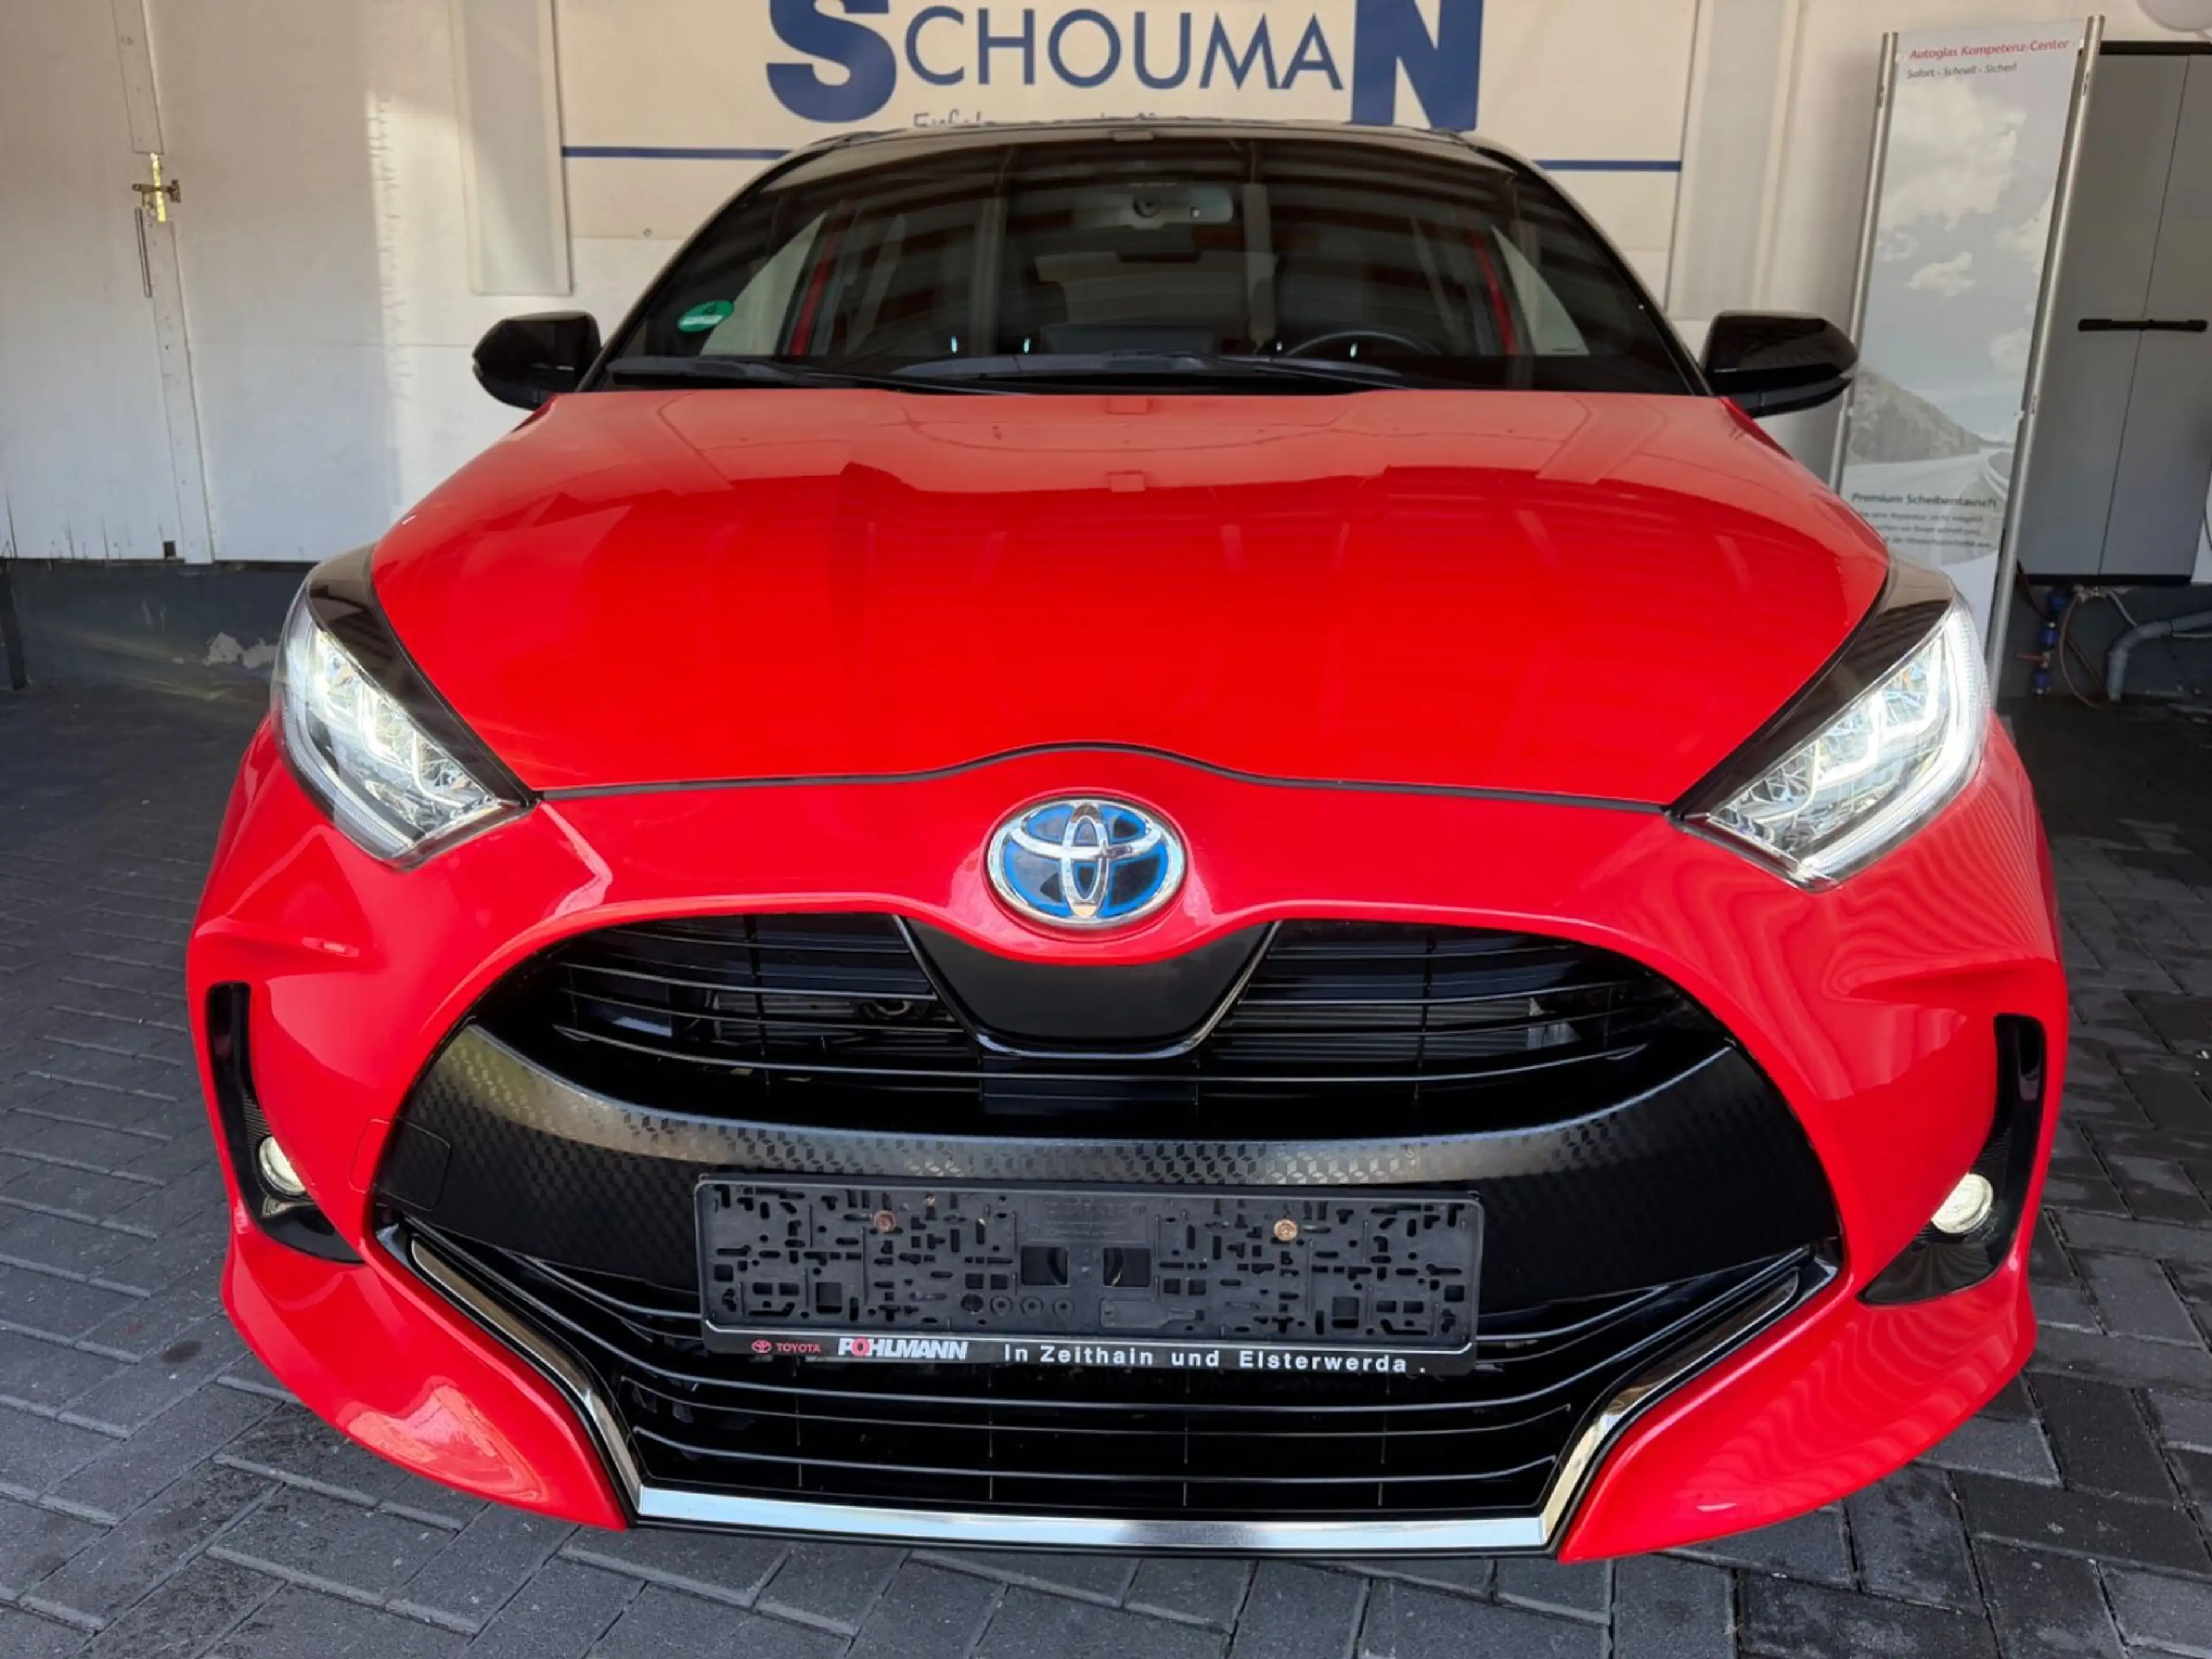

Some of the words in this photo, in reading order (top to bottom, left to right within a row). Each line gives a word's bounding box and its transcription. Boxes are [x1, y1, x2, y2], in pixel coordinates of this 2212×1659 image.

[1910, 46, 1957, 60] Autoglas
[766, 0, 1484, 131] SCHOUMAN
[1851, 493, 1903, 502] Premium
[776, 1342, 820, 1353] TOYOTA
[1040, 1346, 1153, 1364] Zeithain
[1171, 1350, 1220, 1366] und
[1239, 1350, 1407, 1373] Elsterwerda
